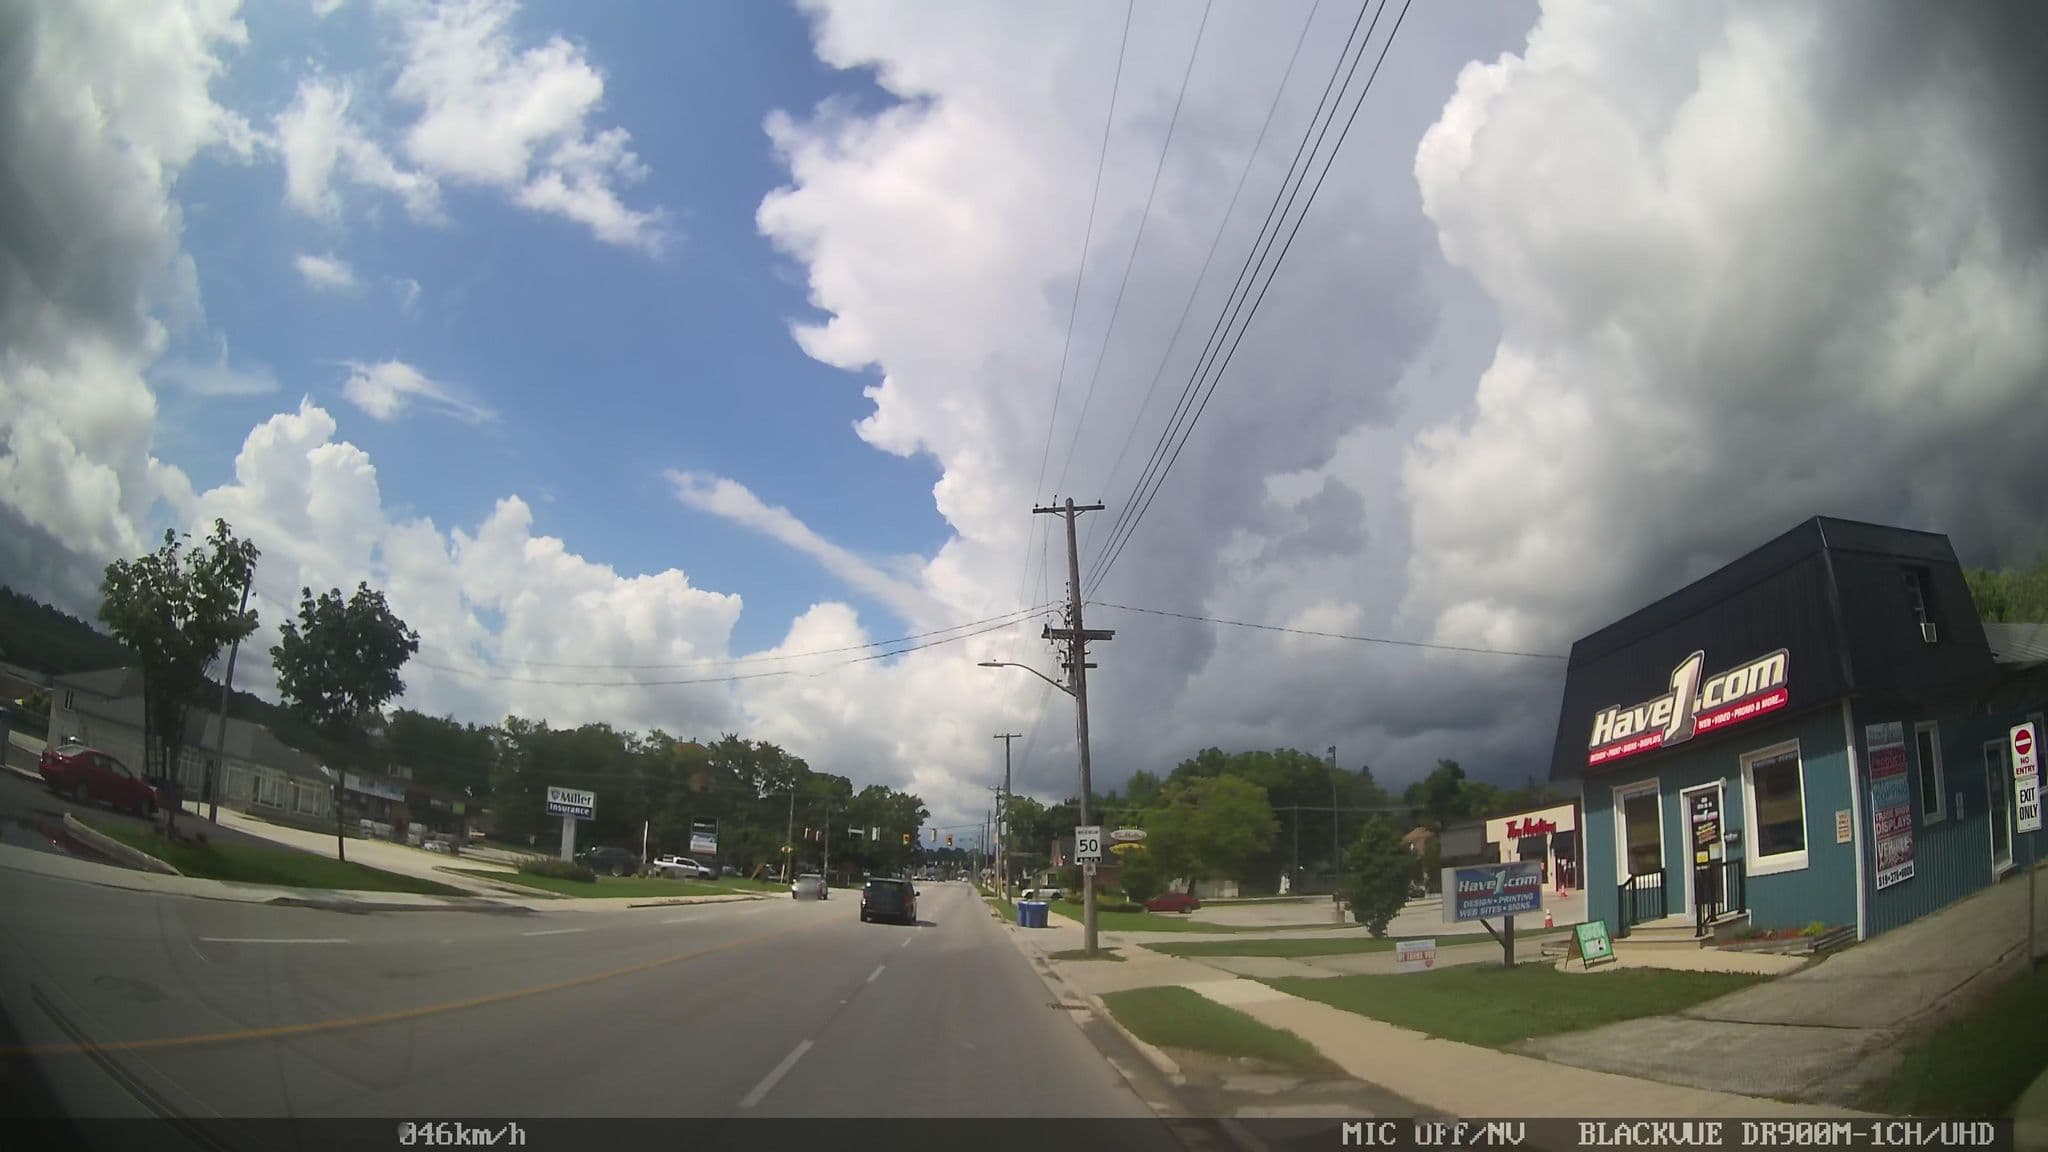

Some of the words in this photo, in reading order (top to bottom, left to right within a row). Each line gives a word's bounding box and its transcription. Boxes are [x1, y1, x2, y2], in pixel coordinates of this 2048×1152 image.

[1590, 655, 1785, 747] Have1.com
[2020, 756, 2030, 764] NO
[2016, 765, 2035, 775] ENTRY
[561, 791, 591, 805] Miller
[2020, 787, 2035, 803] EXIT
[550, 803, 590, 816] Insurance
[2020, 804, 2038, 820] ONLY
[1876, 815, 1911, 834] DISPLAYS
[1080, 839, 1098, 852] 50
[1459, 871, 1537, 895] Have1.com
[1463, 898, 1495, 909] DESIGN
[1498, 892, 1534, 904] PRINTING
[1460, 907, 1478, 918] WEB
[1480, 905, 1501, 915] SITES
[1507, 901, 1531, 911] SIGNS
